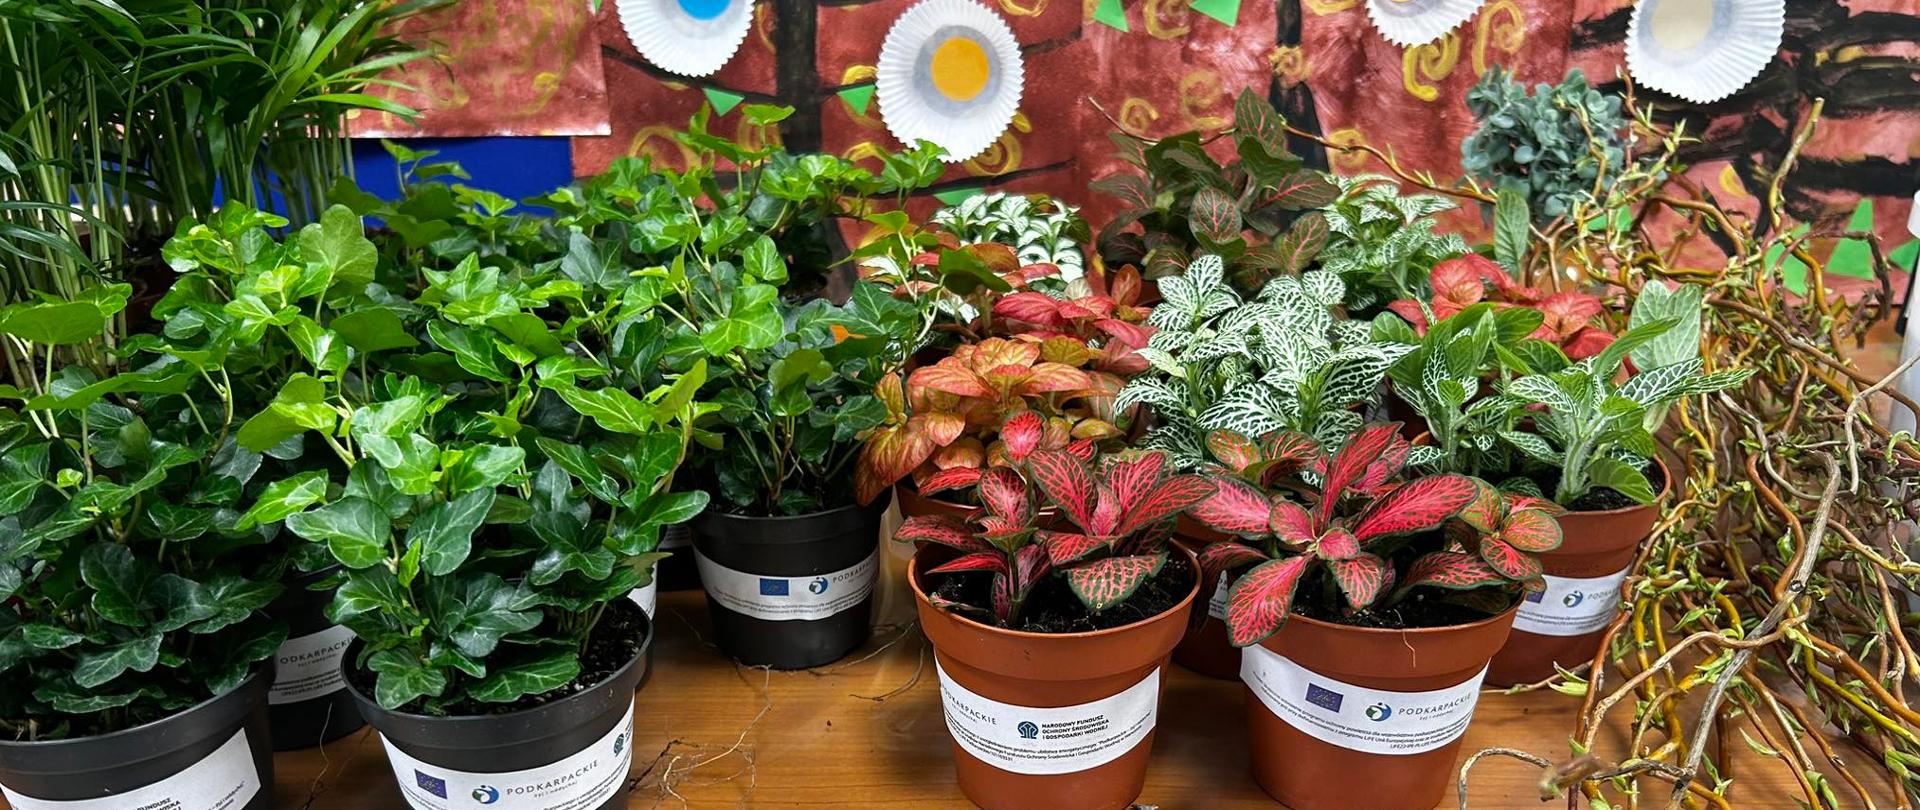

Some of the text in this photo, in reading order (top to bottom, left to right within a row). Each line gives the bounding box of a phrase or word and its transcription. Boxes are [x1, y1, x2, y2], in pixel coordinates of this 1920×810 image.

[1398, 693, 1472, 716] PODKARPACKIE
[1042, 714, 1104, 730] NARODOWY FUNDUSZ
[1042, 718, 1110, 735] OCHRONY ŚRODOWISKA
[1046, 731, 1083, 740] GOSPODARKI
[1084, 724, 1109, 735] WODNEJ
[507, 760, 599, 796] PODKARPACKIE
